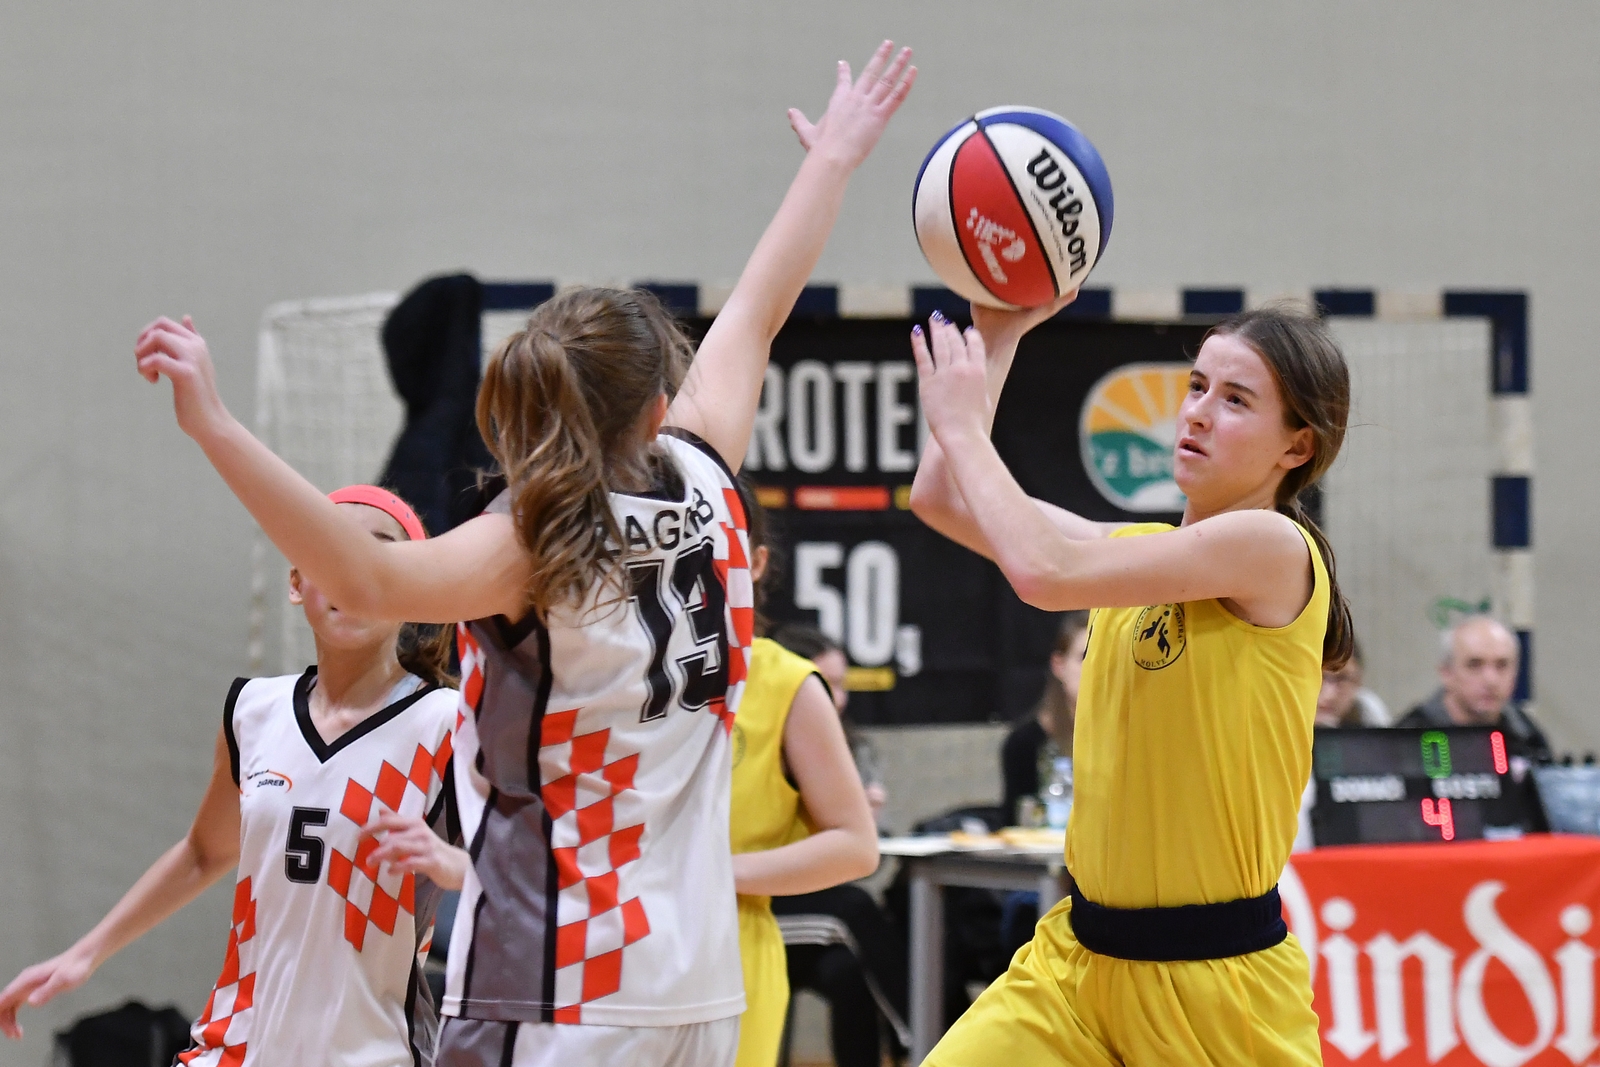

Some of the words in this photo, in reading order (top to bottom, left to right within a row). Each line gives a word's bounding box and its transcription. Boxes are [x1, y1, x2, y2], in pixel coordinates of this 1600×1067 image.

[1026, 147, 1087, 279] Wilson
[743, 360, 931, 473] ROTE
[623, 536, 729, 723] 13
[1140, 658, 1167, 668] MOLVE
[1420, 731, 1452, 779] 0
[1490, 730, 1508, 775] 1
[285, 806, 330, 884] 5
[1421, 797, 1454, 841] 4
[1279, 861, 1600, 1067] indi
